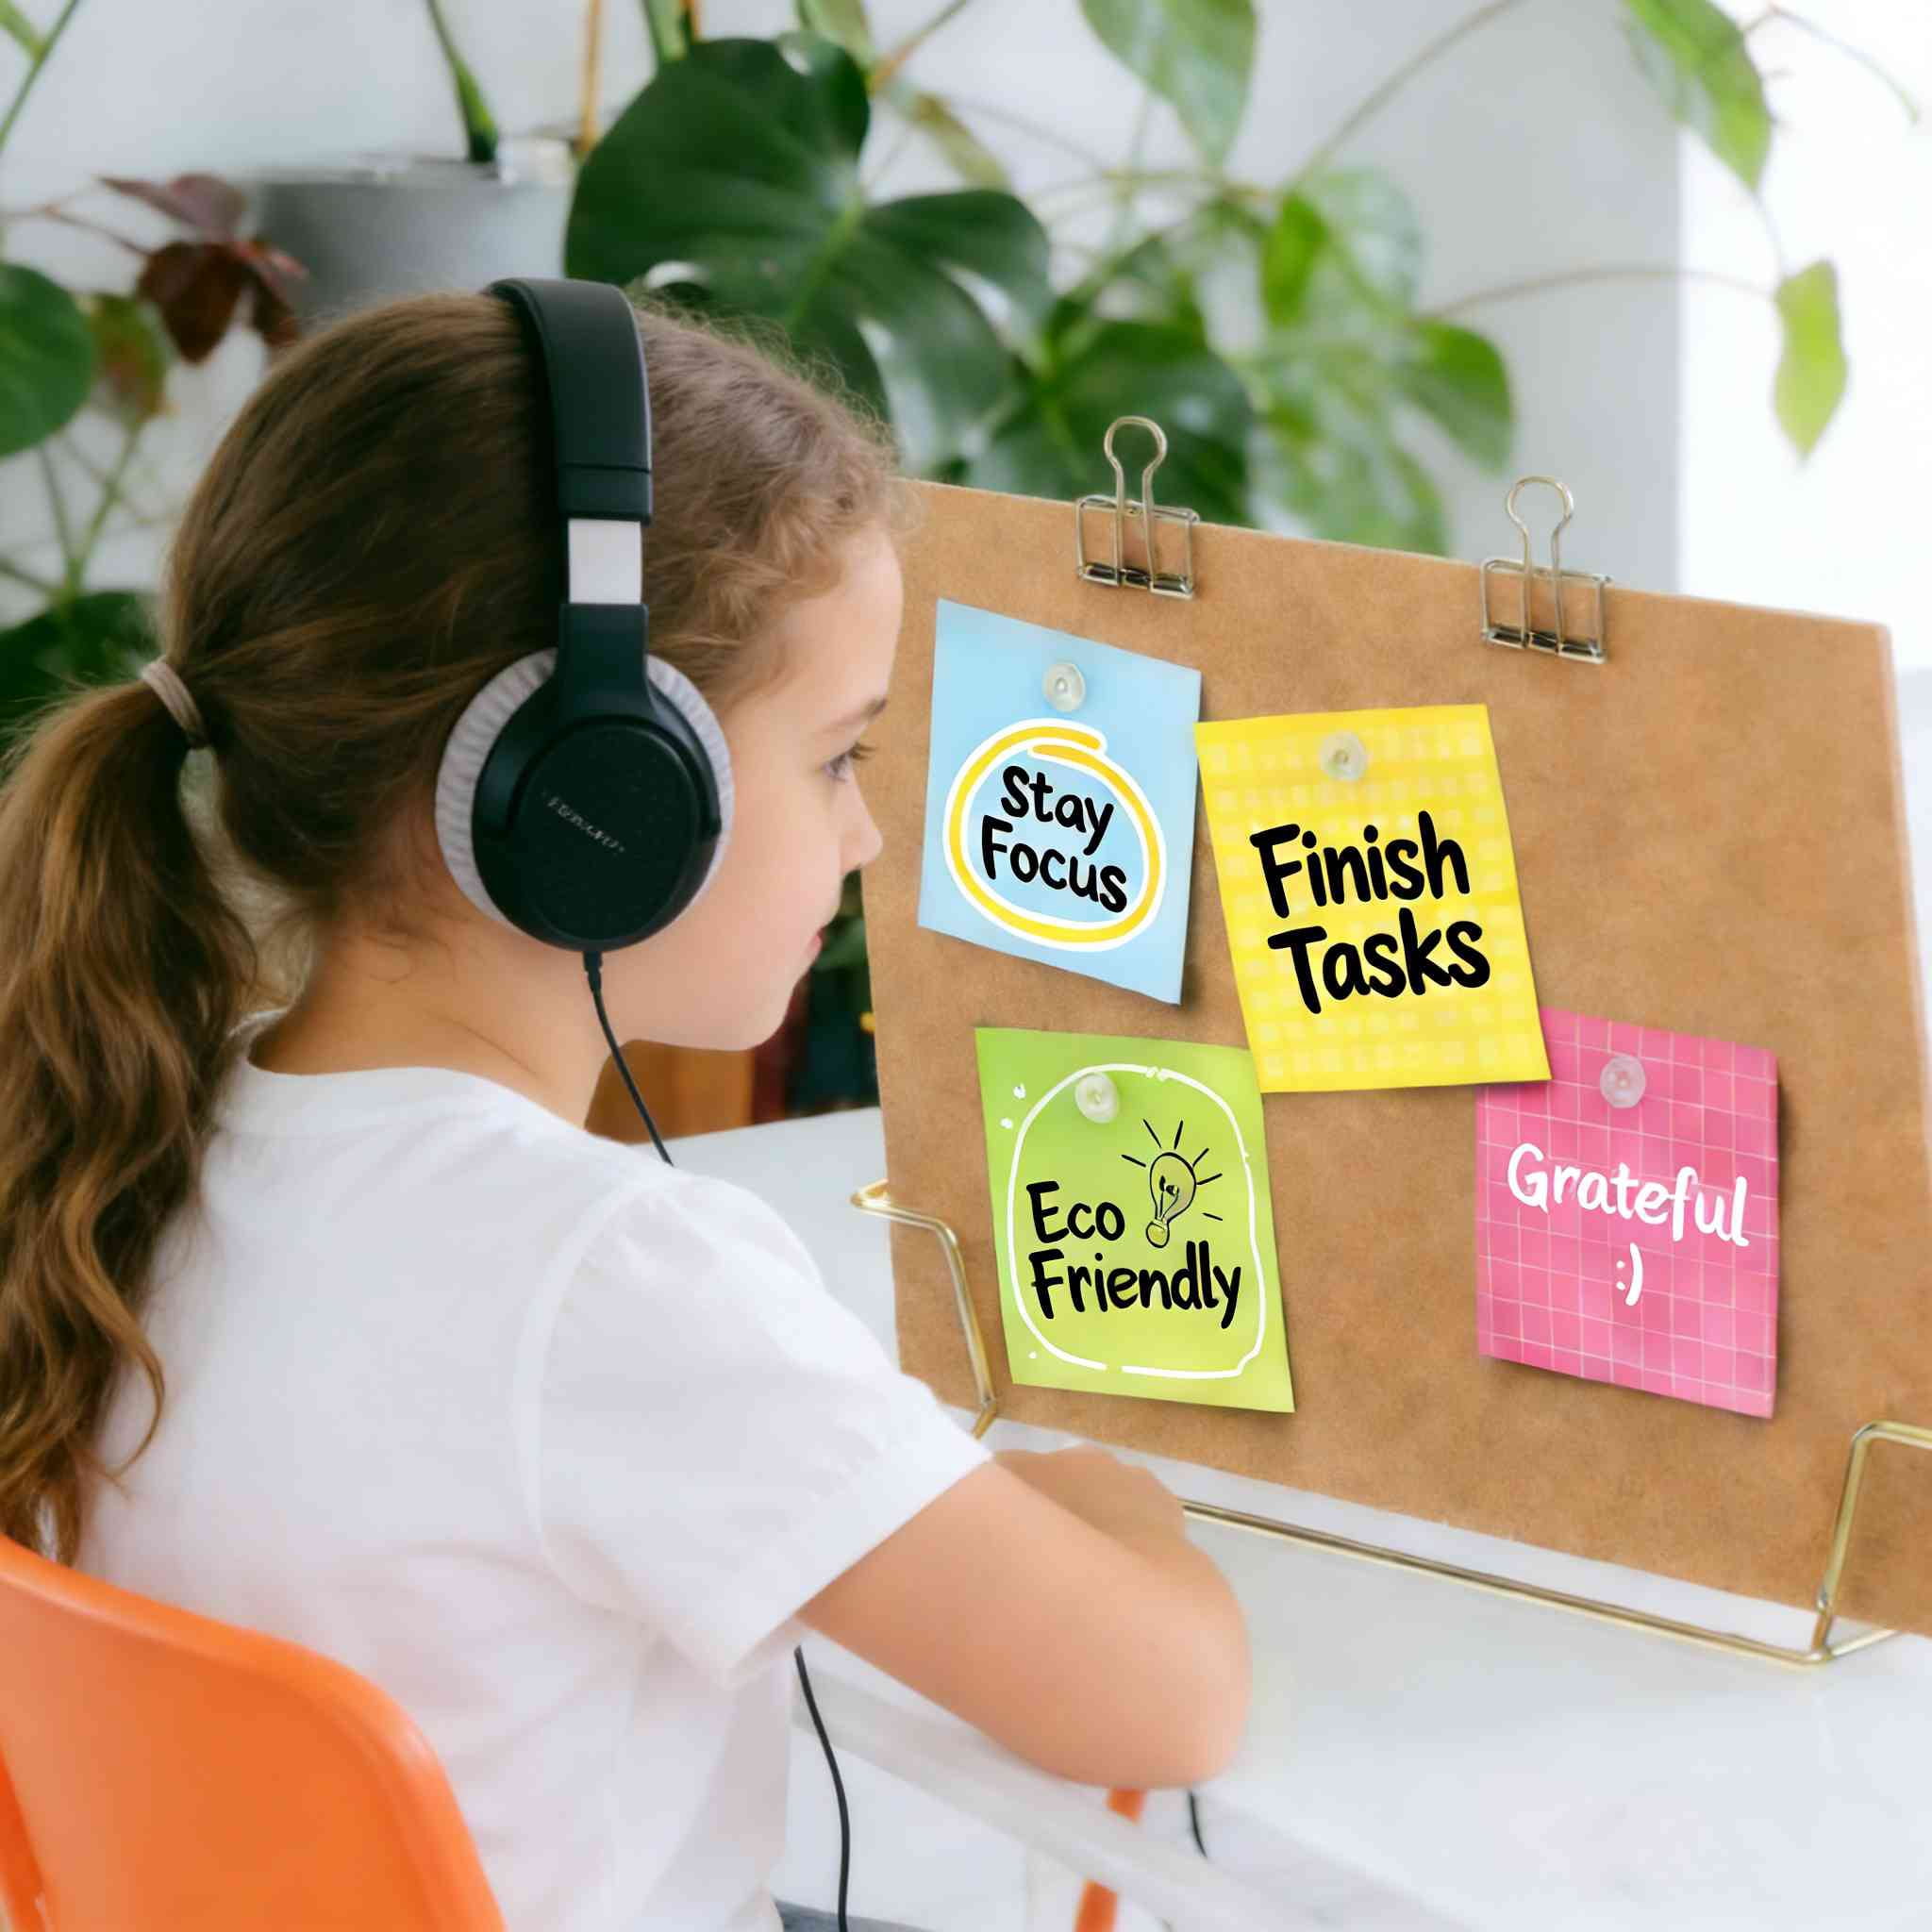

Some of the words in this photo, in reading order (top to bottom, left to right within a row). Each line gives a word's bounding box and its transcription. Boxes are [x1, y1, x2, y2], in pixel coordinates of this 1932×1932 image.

[1000, 765, 1114, 856] Stay
[981, 814, 1127, 913] Focus
[1249, 810, 1471, 919] Finish
[1267, 908, 1491, 1014] Tasks
[1025, 1180, 1125, 1244] Eco
[1507, 1142, 1750, 1247] Grateful
[1028, 1240, 1241, 1329] Friendly
